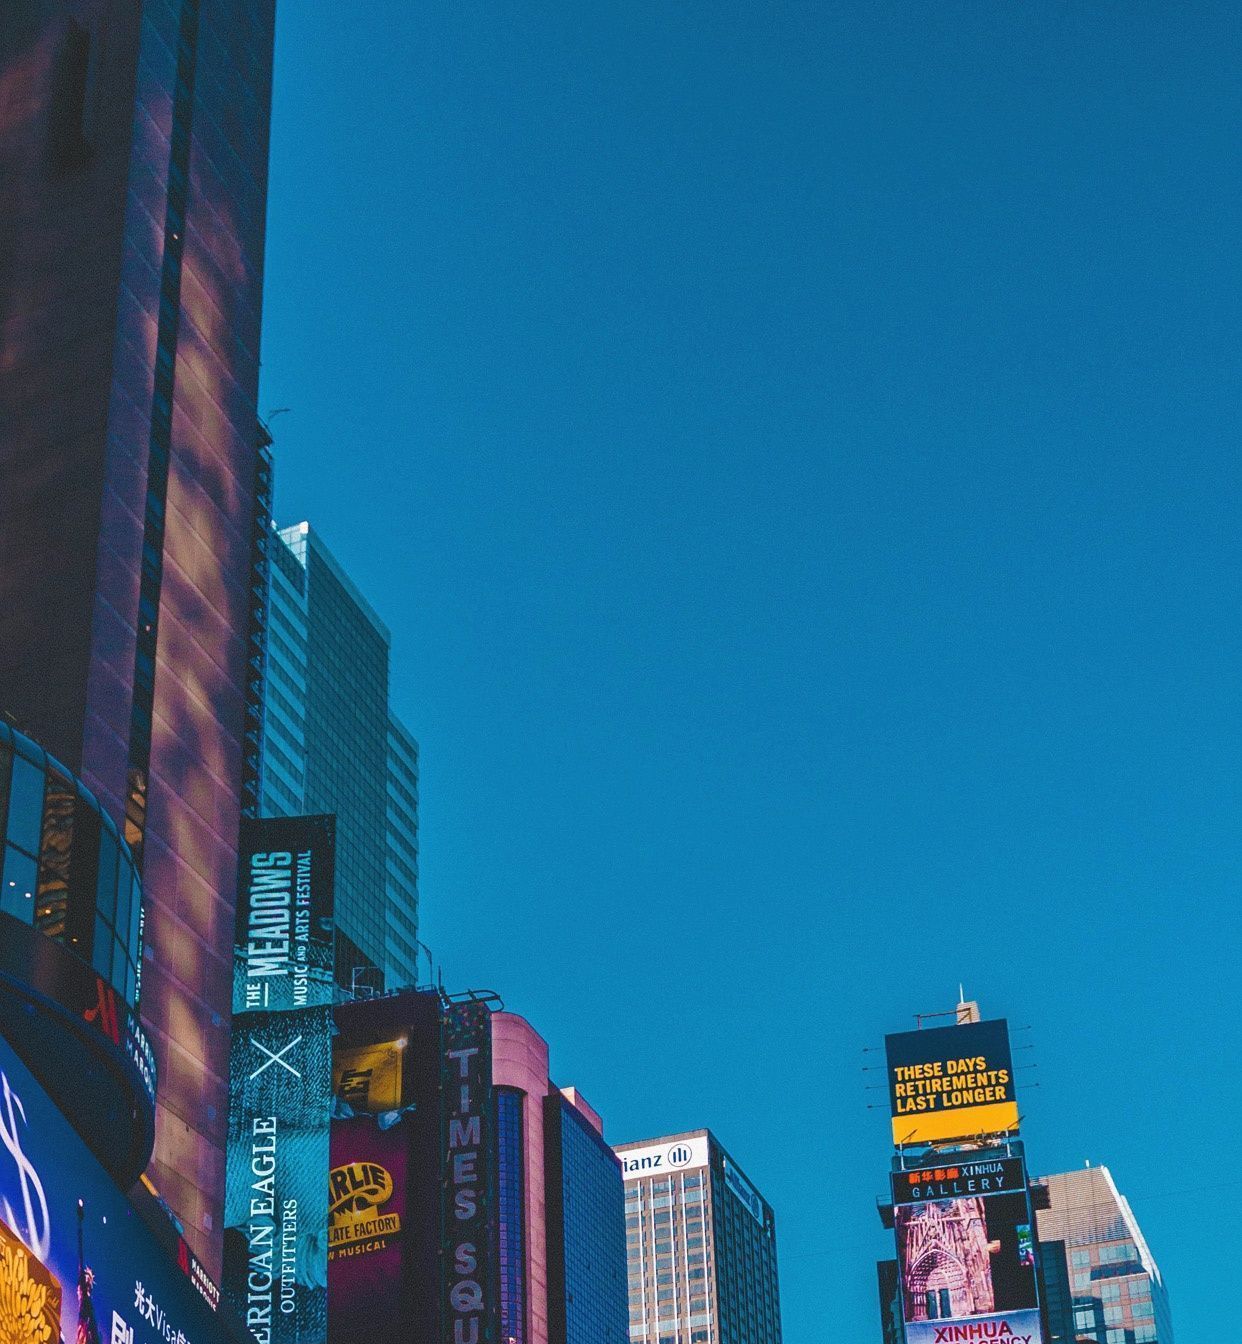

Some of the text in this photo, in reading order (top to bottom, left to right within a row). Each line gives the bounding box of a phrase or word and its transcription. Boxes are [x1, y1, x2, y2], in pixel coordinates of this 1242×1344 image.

[246, 851, 292, 1008] THE MEADOWS
[294, 850, 312, 1006] MUSIC AND ARTS FESTIVAL
[894, 1056, 987, 1083] THESE DAYS
[895, 1069, 1009, 1098] RETIREMENTS
[896, 1086, 1007, 1113] LAST LONGER
[448, 1047, 482, 1221] TIMES
[251, 1116, 277, 1217] EAGLE
[962, 1163, 1004, 1177] XINHUA
[330, 1164, 386, 1202] RLIE
[912, 1177, 1004, 1198] GALLERY
[354, 1216, 397, 1238] FACTORY
[280, 1199, 297, 1313] OUTFITTERS
[339, 1240, 387, 1258] MUSICAL
[933, 1321, 1014, 1344] XINHUA
